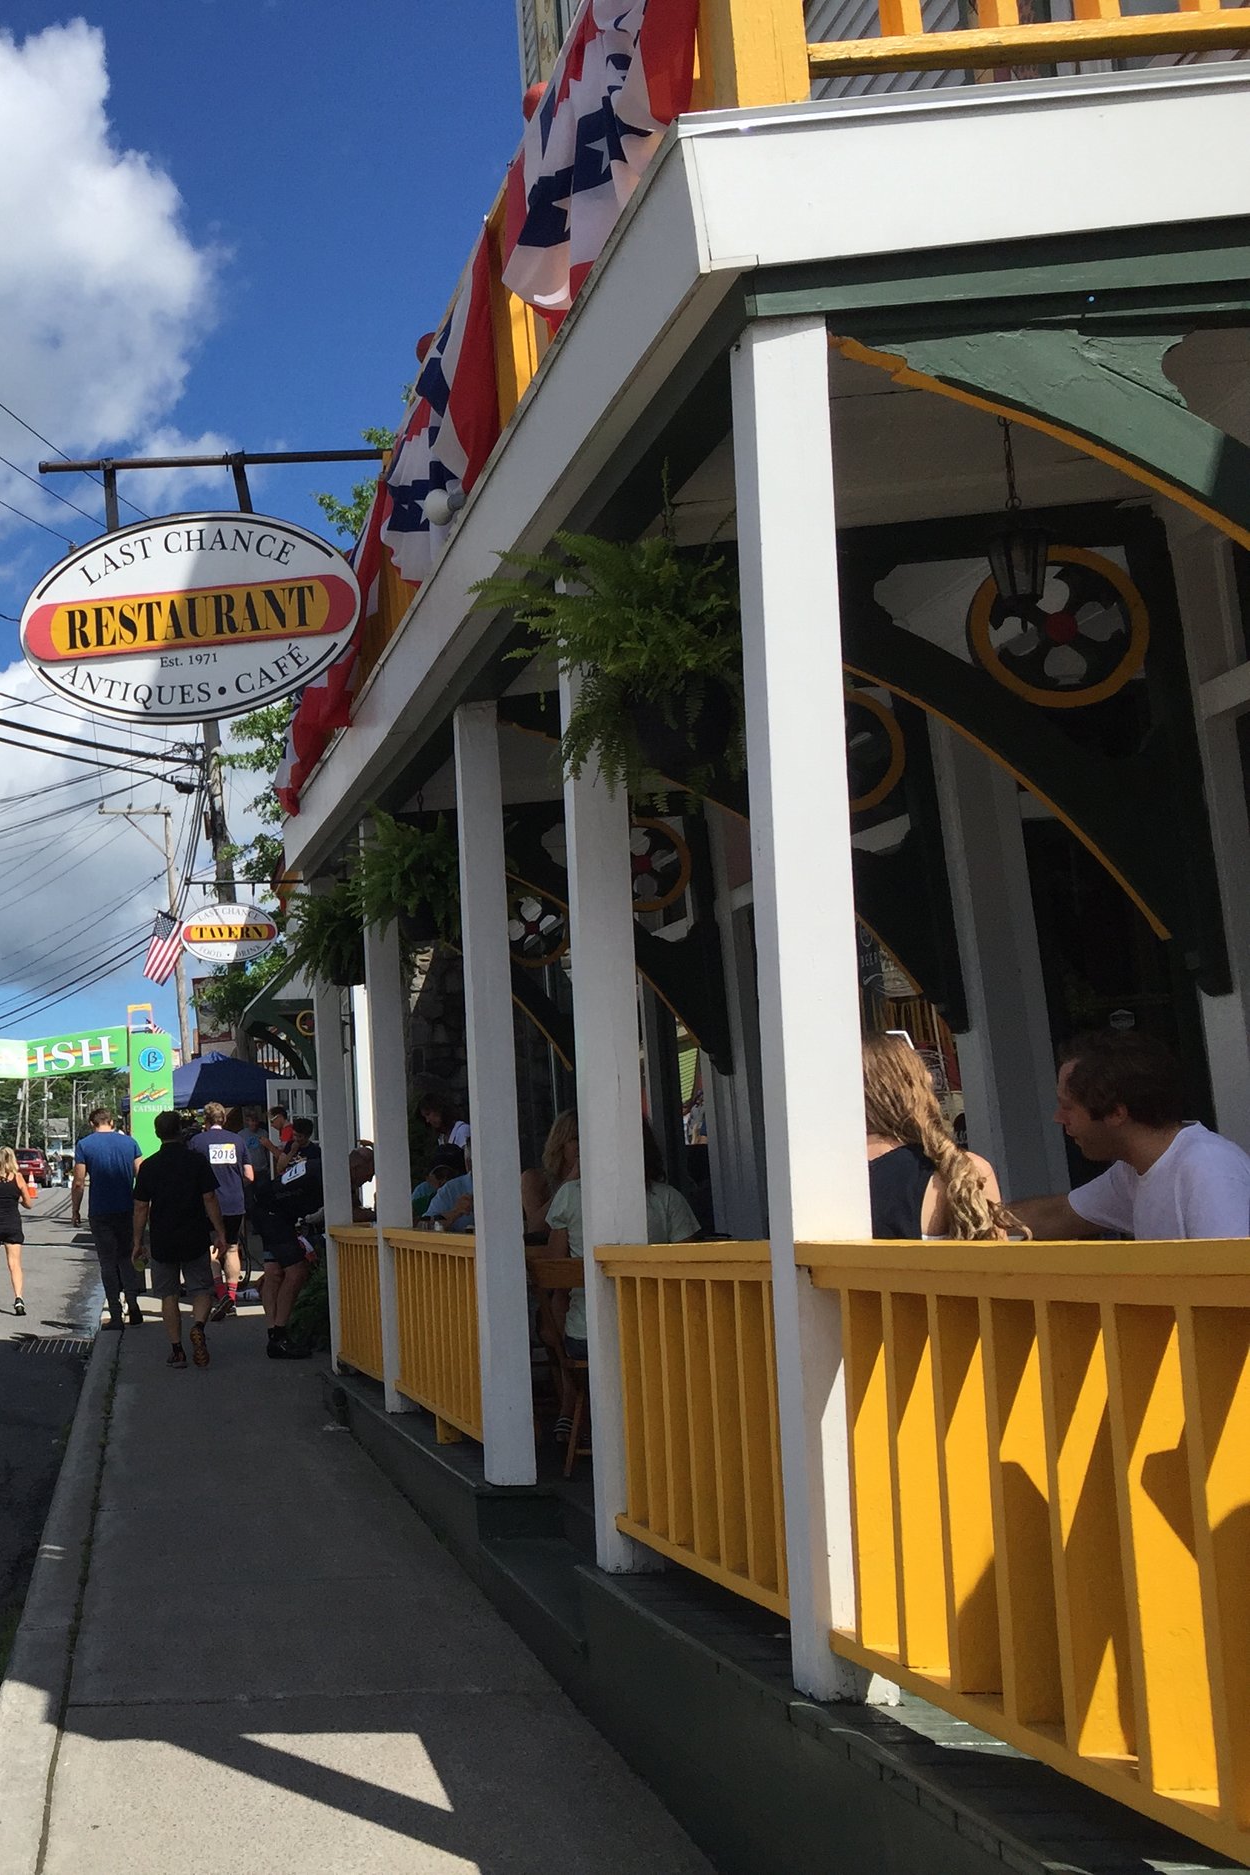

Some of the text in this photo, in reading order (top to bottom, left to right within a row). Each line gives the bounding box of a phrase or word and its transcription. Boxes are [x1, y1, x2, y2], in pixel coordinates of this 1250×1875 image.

[79, 528, 296, 587] LAST CHANCE
[64, 584, 315, 651] RESTAURANT
[159, 652, 218, 669] Est. 1971
[60, 643, 310, 711] ANTIQUES CAFÉ
[197, 907, 259, 922] LAST CHANCE
[195, 926, 263, 939] TAVERN
[235, 945, 262, 958] DRINK
[133, 1104, 174, 1113] CATSKILLS
[211, 1149, 236, 1161] 2018
